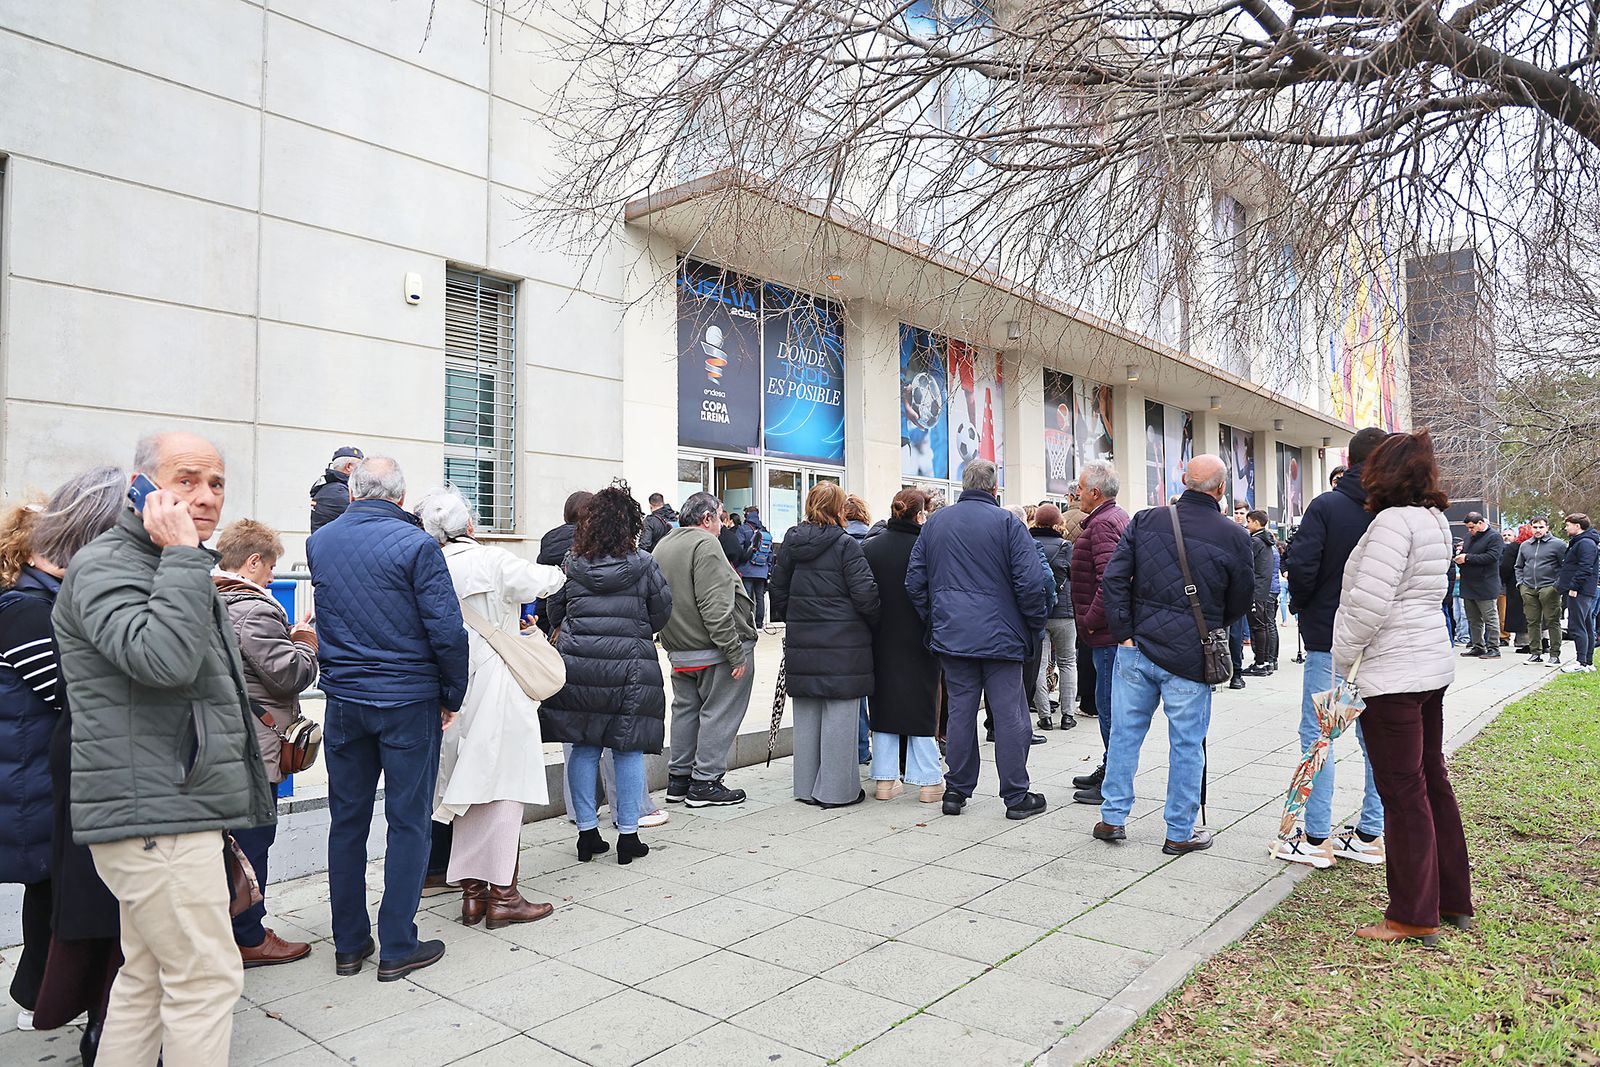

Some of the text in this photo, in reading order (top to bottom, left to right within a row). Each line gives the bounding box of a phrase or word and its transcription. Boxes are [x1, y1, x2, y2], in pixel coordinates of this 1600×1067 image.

[777, 342, 827, 368] DONDE
[703, 388, 726, 398] endesa
[767, 377, 841, 406] ES POSIBLE
[702, 400, 728, 414] COPA
[706, 411, 731, 424] REINA
